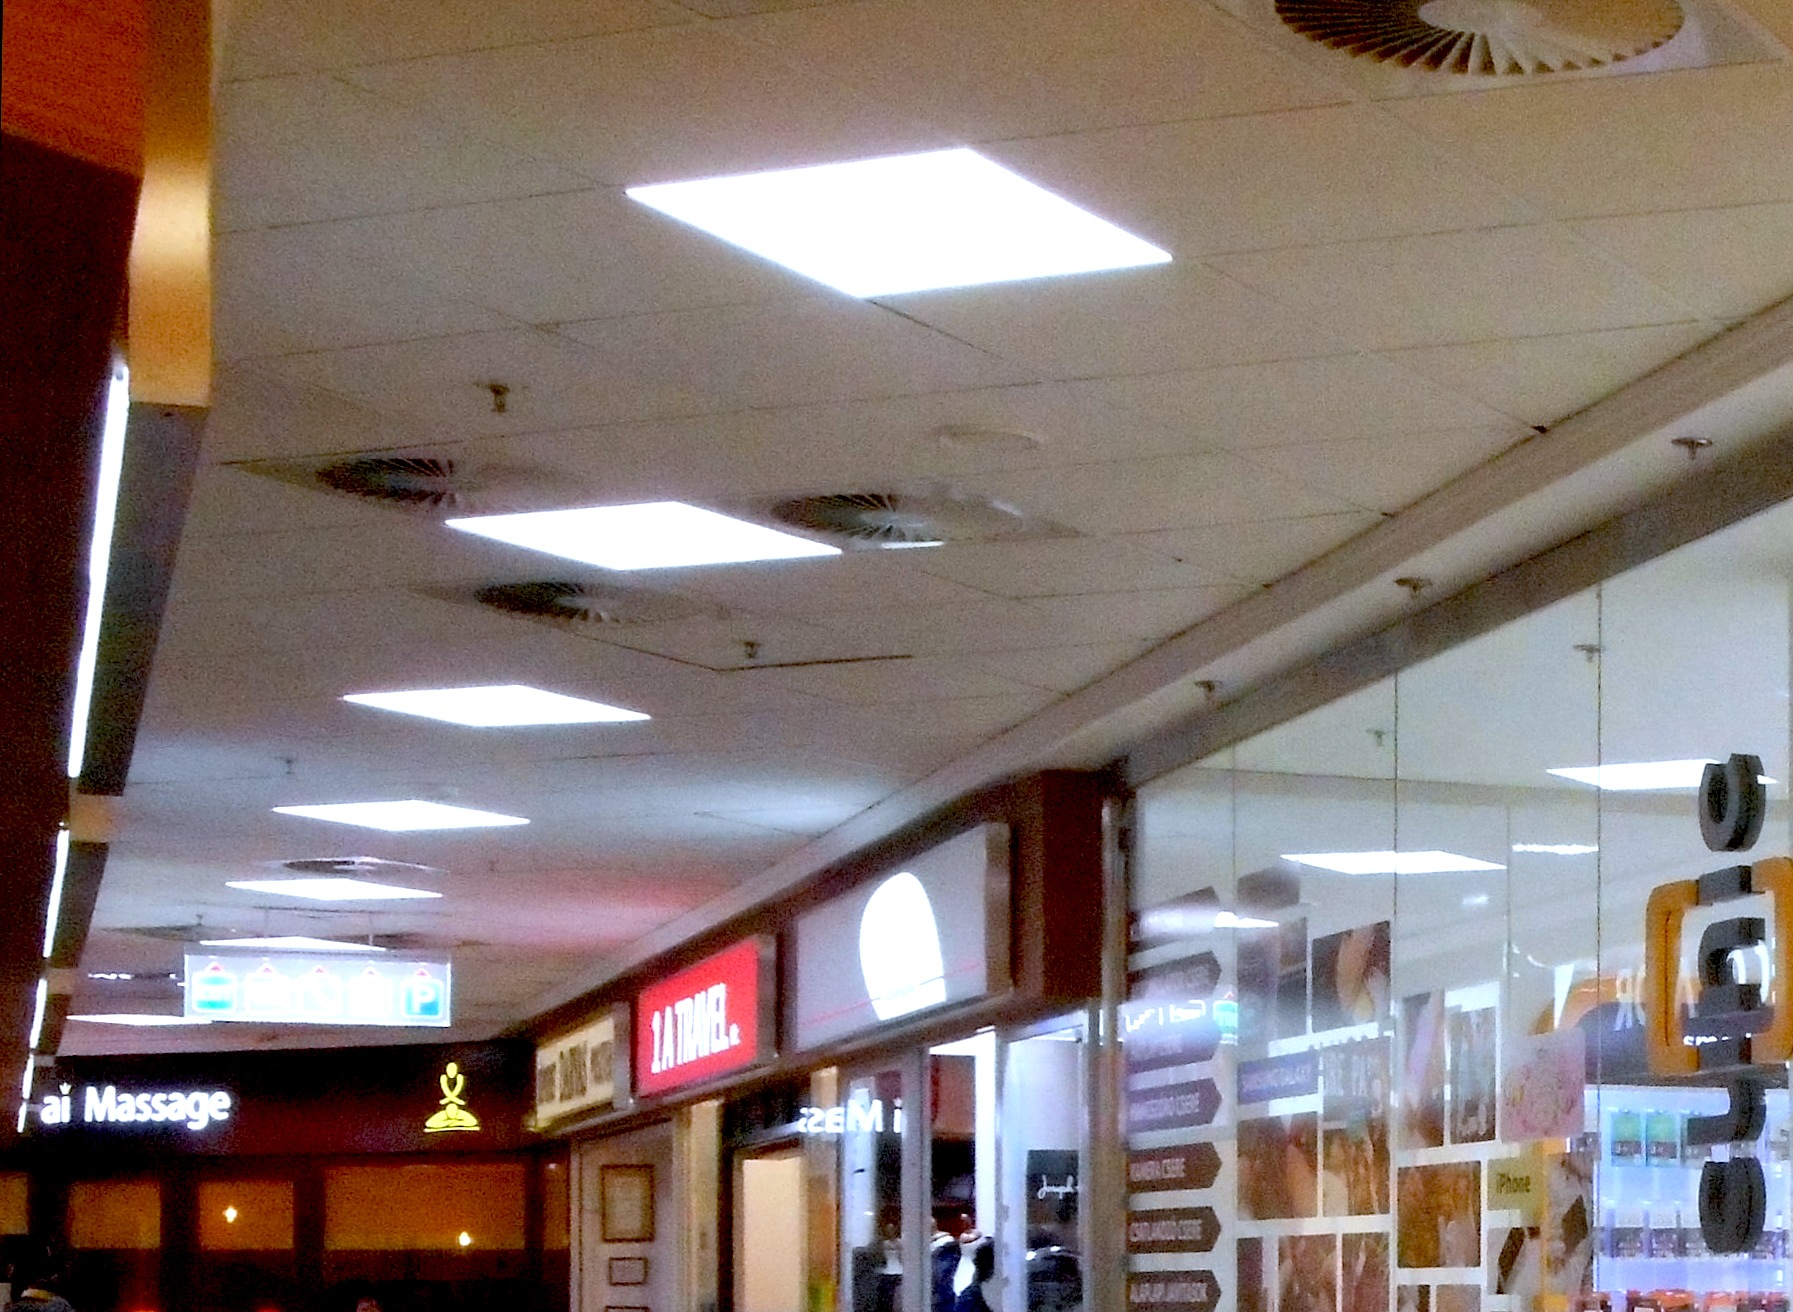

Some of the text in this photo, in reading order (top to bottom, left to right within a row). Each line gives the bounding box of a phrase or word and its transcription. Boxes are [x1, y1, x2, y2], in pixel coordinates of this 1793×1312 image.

[675, 982, 729, 1065] TRAVEL
[40, 1083, 232, 1130] ai Massage
[1495, 1172, 1531, 1195] iPhone
